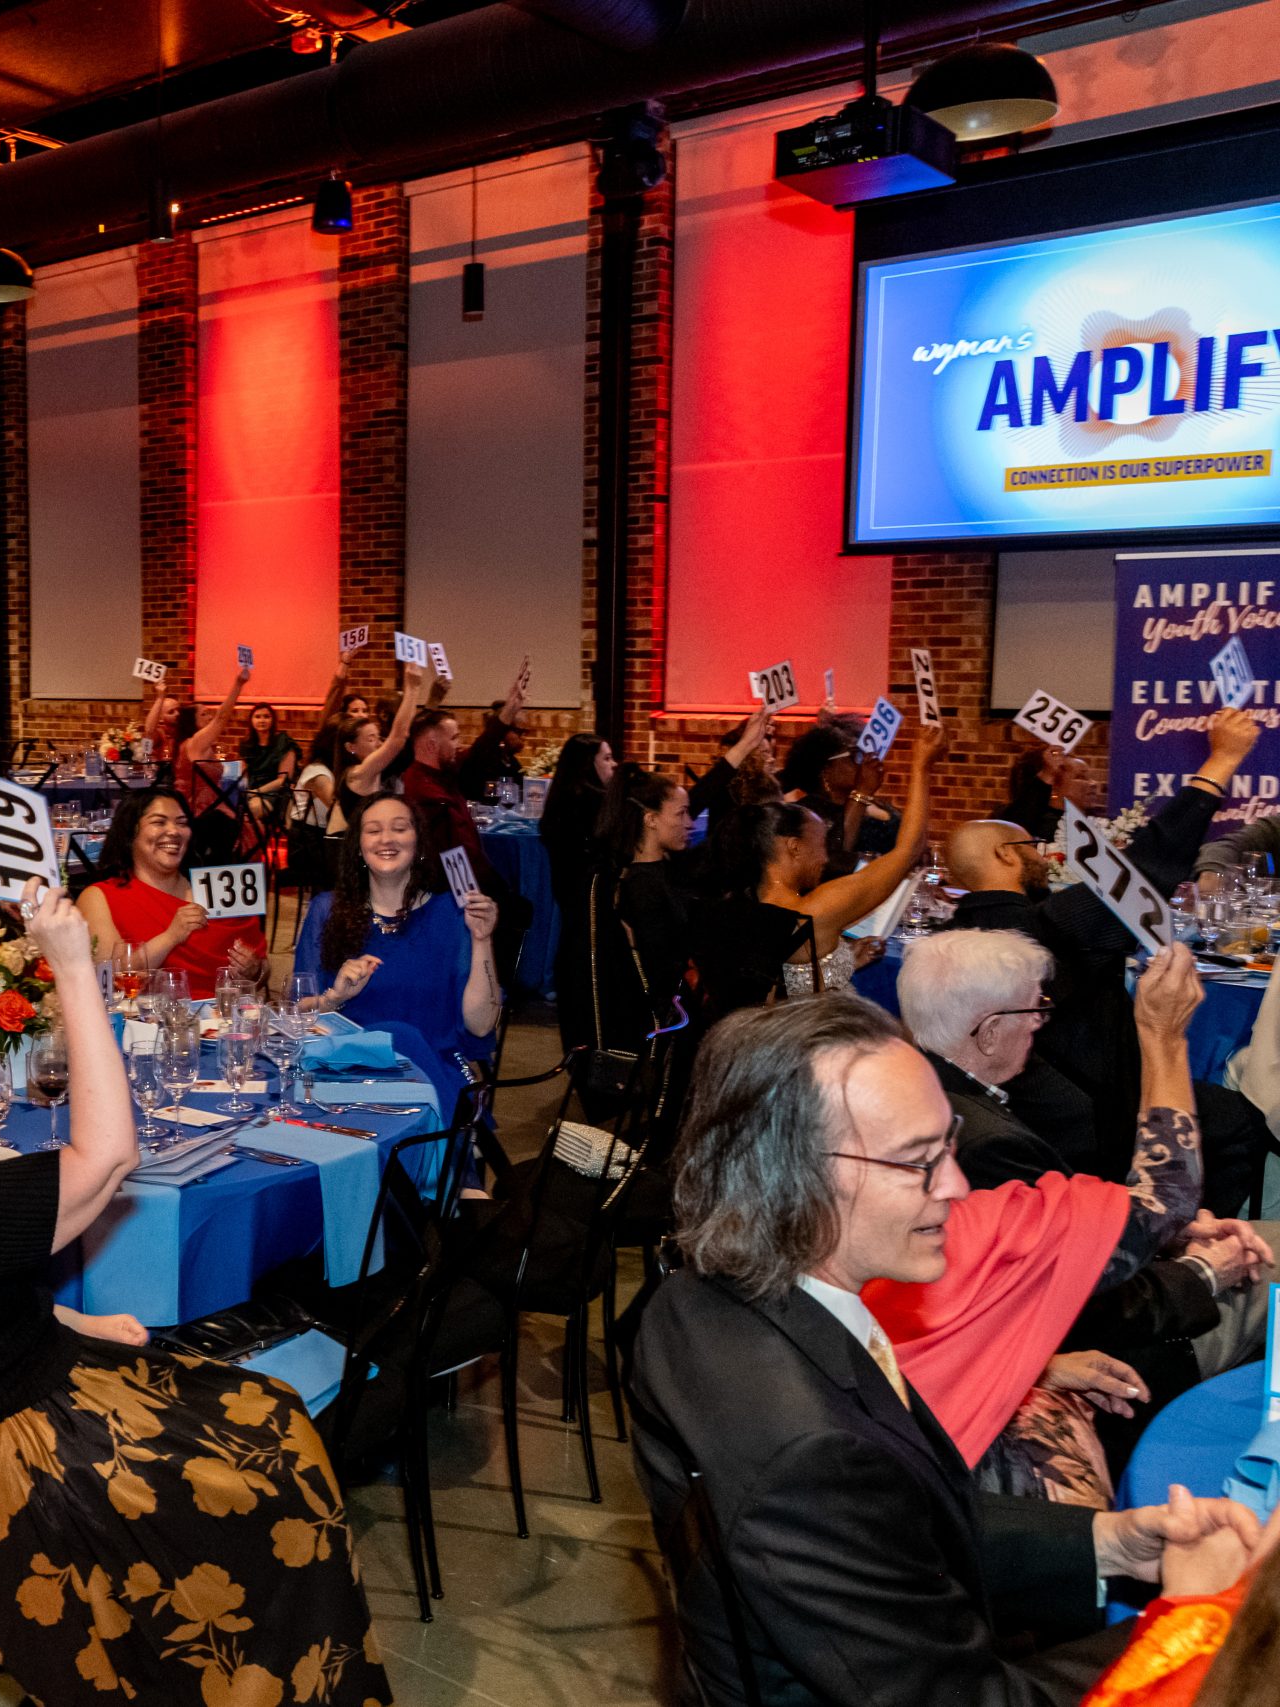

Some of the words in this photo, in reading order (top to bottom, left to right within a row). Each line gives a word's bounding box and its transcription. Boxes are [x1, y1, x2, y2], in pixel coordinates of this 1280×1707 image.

[977, 329, 1280, 431] AMPLIF
[1010, 466, 1099, 486] CONNECTION
[1102, 465, 1116, 480] IS
[1120, 462, 1150, 479] OUR
[1153, 454, 1265, 477] SUPERPOWER
[342, 628, 367, 647] 158
[1142, 601, 1225, 653] Youth
[137, 661, 163, 679] 145
[399, 637, 424, 661] 151
[760, 664, 794, 705] 203
[914, 653, 939, 721] 204
[1131, 680, 1280, 704] ELEVT
[863, 703, 895, 753] 296
[1022, 696, 1084, 745] 256
[198, 869, 258, 910] 138
[445, 853, 475, 896] 212
[1073, 819, 1166, 947] 272
